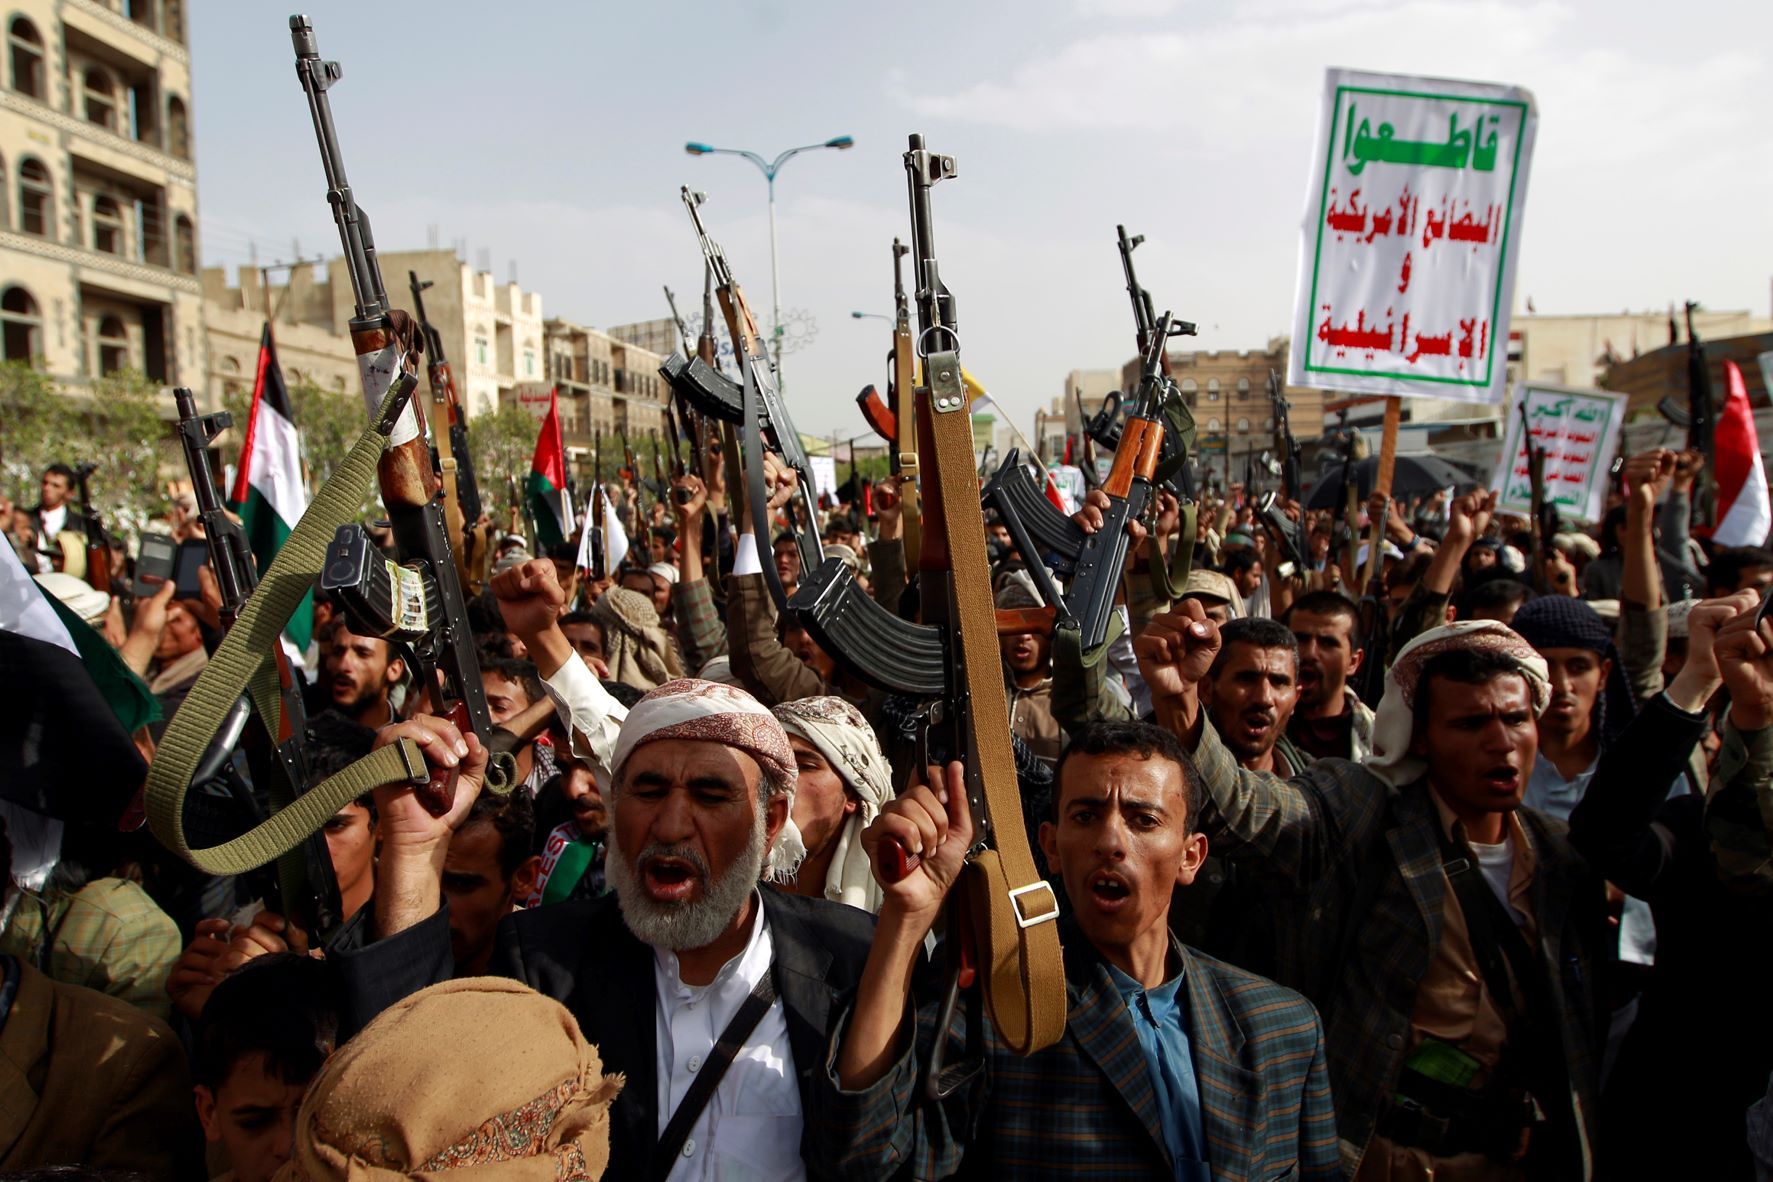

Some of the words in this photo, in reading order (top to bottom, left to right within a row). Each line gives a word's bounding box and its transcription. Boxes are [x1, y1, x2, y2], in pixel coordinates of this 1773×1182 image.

[1344, 103, 1499, 176] قاطعوا
[1422, 192, 1502, 253] البضائع
[1397, 252, 1411, 294] و
[1317, 305, 1489, 370] الإسرائيلية
